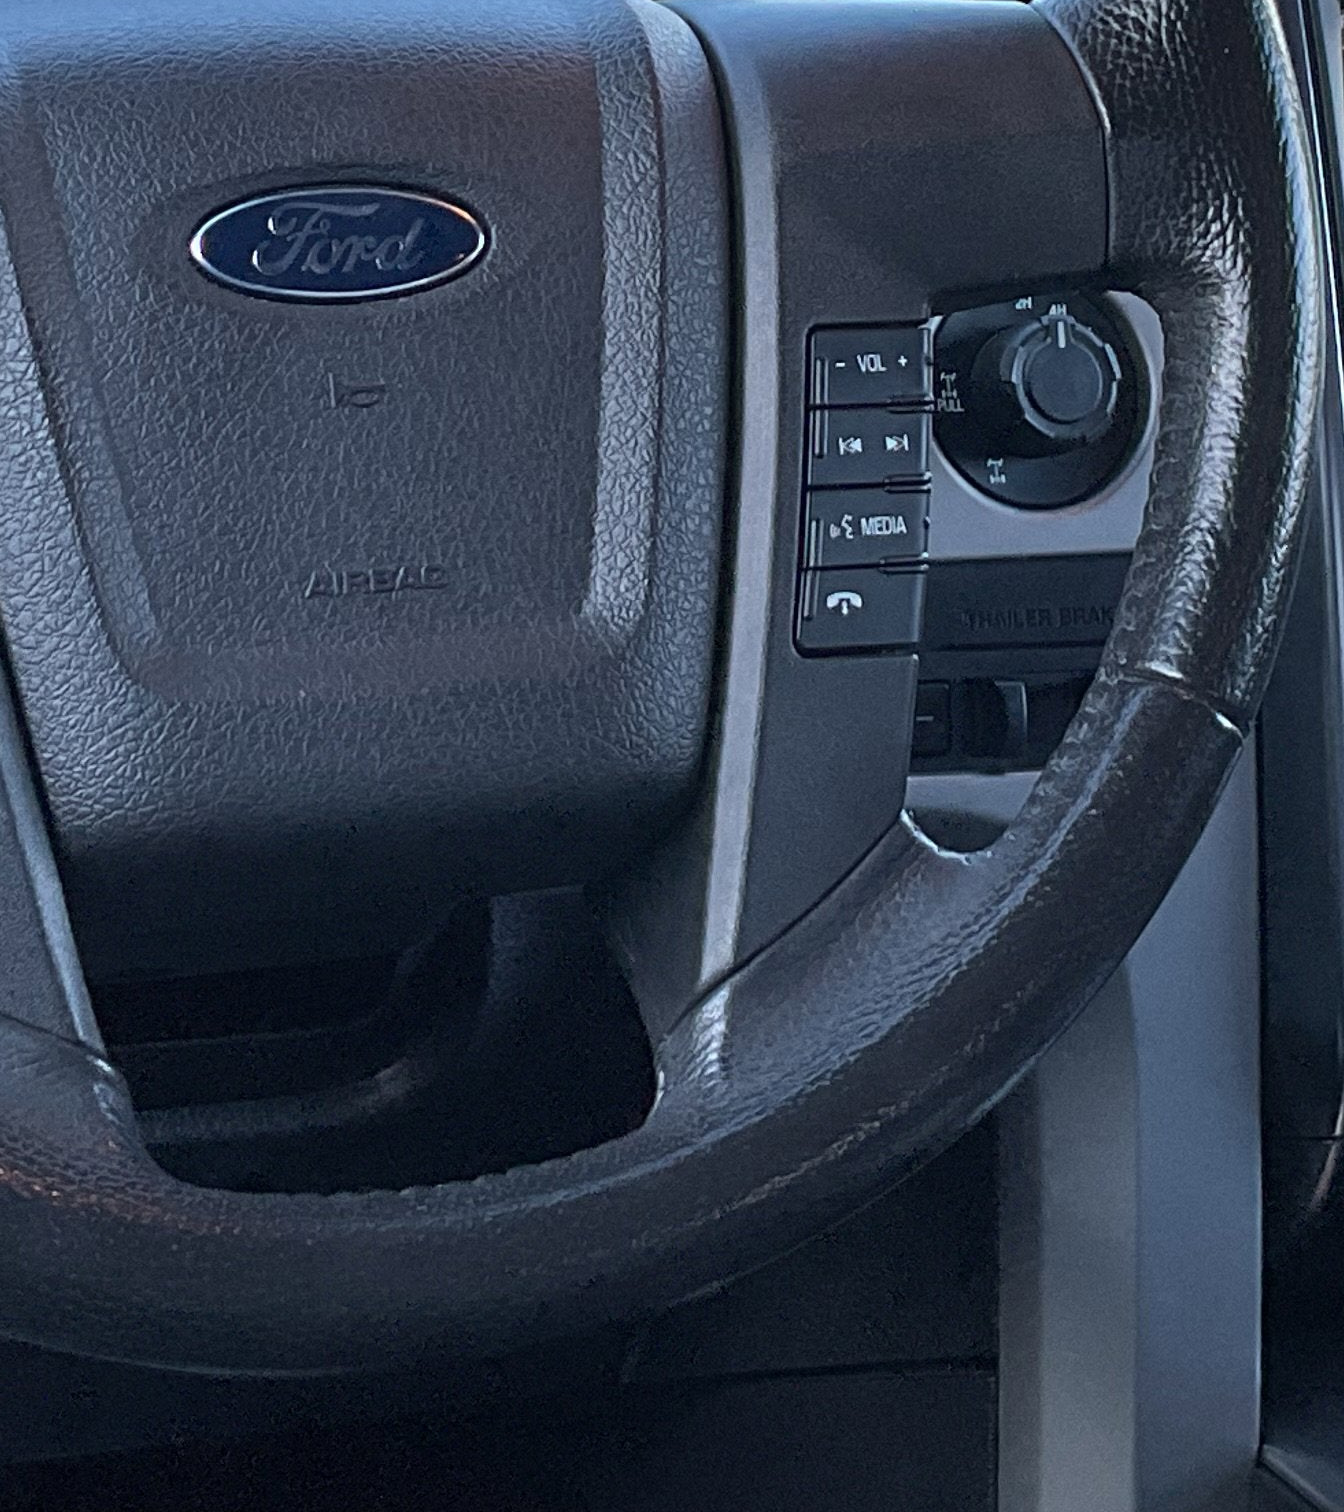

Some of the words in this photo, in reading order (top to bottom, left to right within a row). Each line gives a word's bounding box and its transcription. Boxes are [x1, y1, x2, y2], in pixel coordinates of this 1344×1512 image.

[252, 201, 425, 277] Ford
[857, 353, 888, 373] VOL
[860, 515, 908, 537] MEDIA
